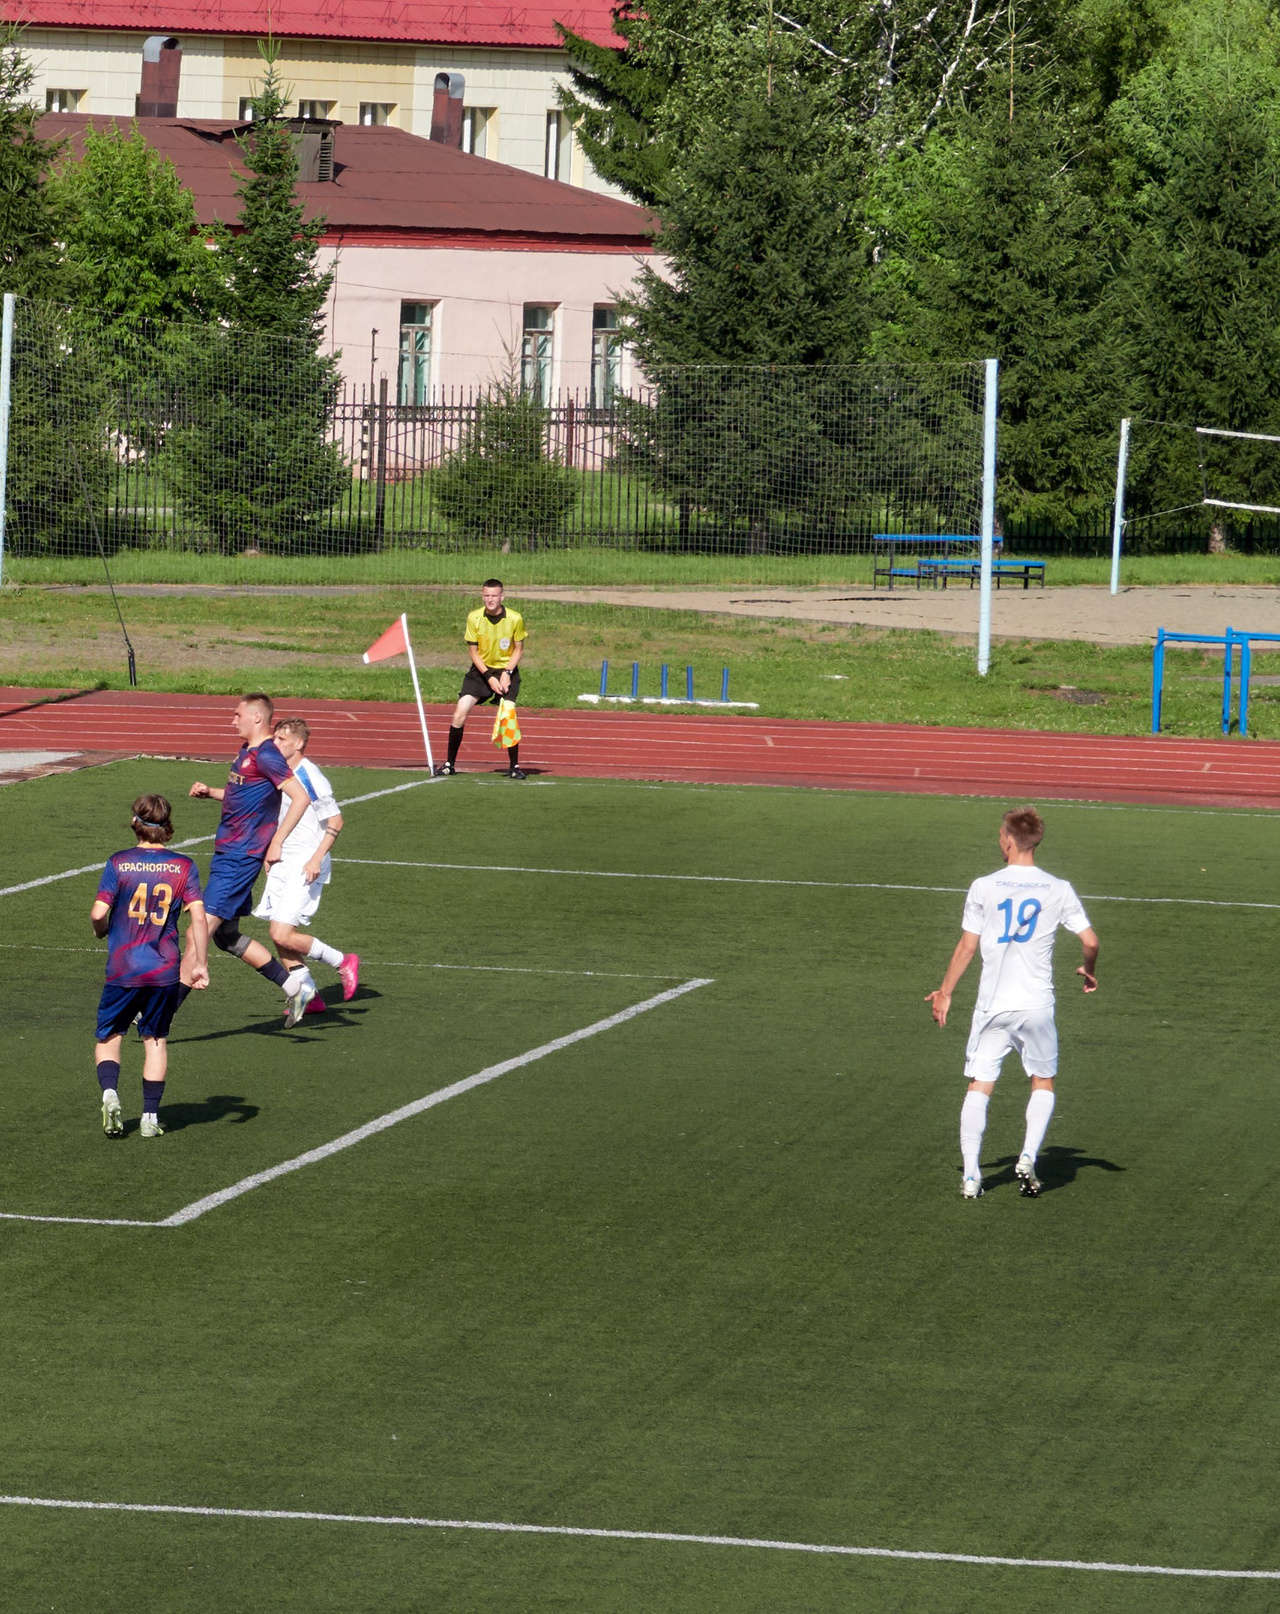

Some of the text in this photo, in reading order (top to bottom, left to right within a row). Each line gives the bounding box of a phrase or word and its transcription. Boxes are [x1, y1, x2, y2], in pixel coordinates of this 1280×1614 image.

[118, 861, 181, 874] КРАСНОЯРСК
[128, 883, 172, 926] 43
[997, 898, 1041, 943] 19
